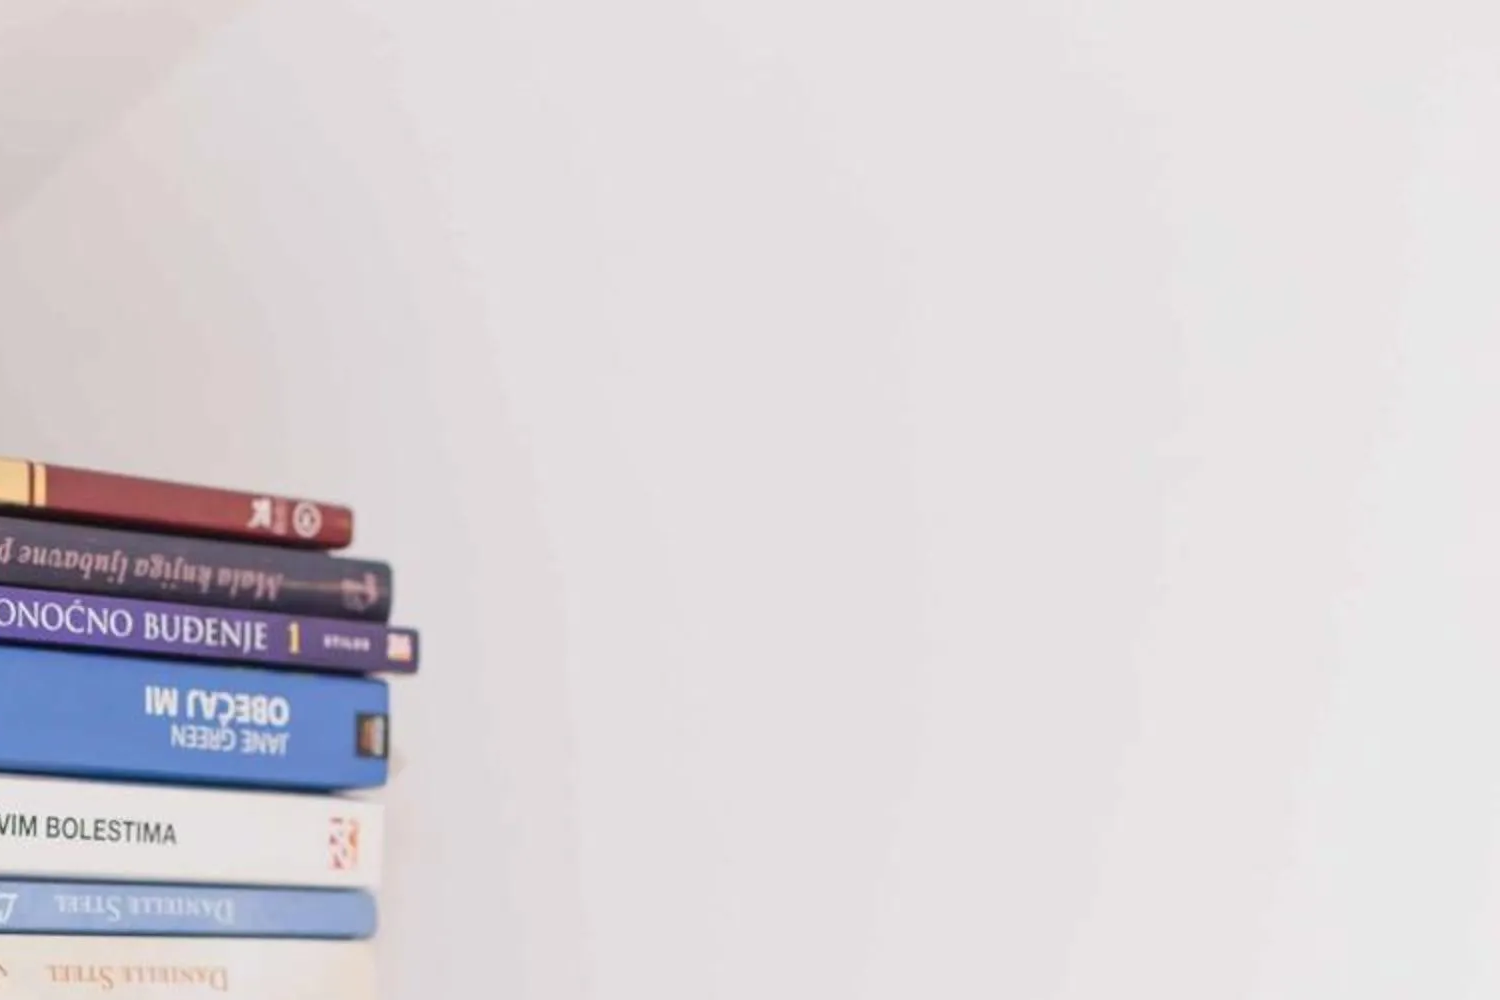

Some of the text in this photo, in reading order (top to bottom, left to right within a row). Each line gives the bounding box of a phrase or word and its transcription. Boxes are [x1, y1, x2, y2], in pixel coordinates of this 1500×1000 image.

[18, 545, 127, 585] ljubavne
[134, 556, 210, 593] knjiga
[217, 567, 284, 601] Mala
[144, 613, 268, 650] BUĐENJE
[146, 686, 289, 727] OBEĆAJ MI
[171, 724, 289, 754] JANE GREEN
[46, 816, 176, 843] BOLESTIMA
[54, 894, 121, 921] STEEL
[49, 965, 114, 989] STEEL
